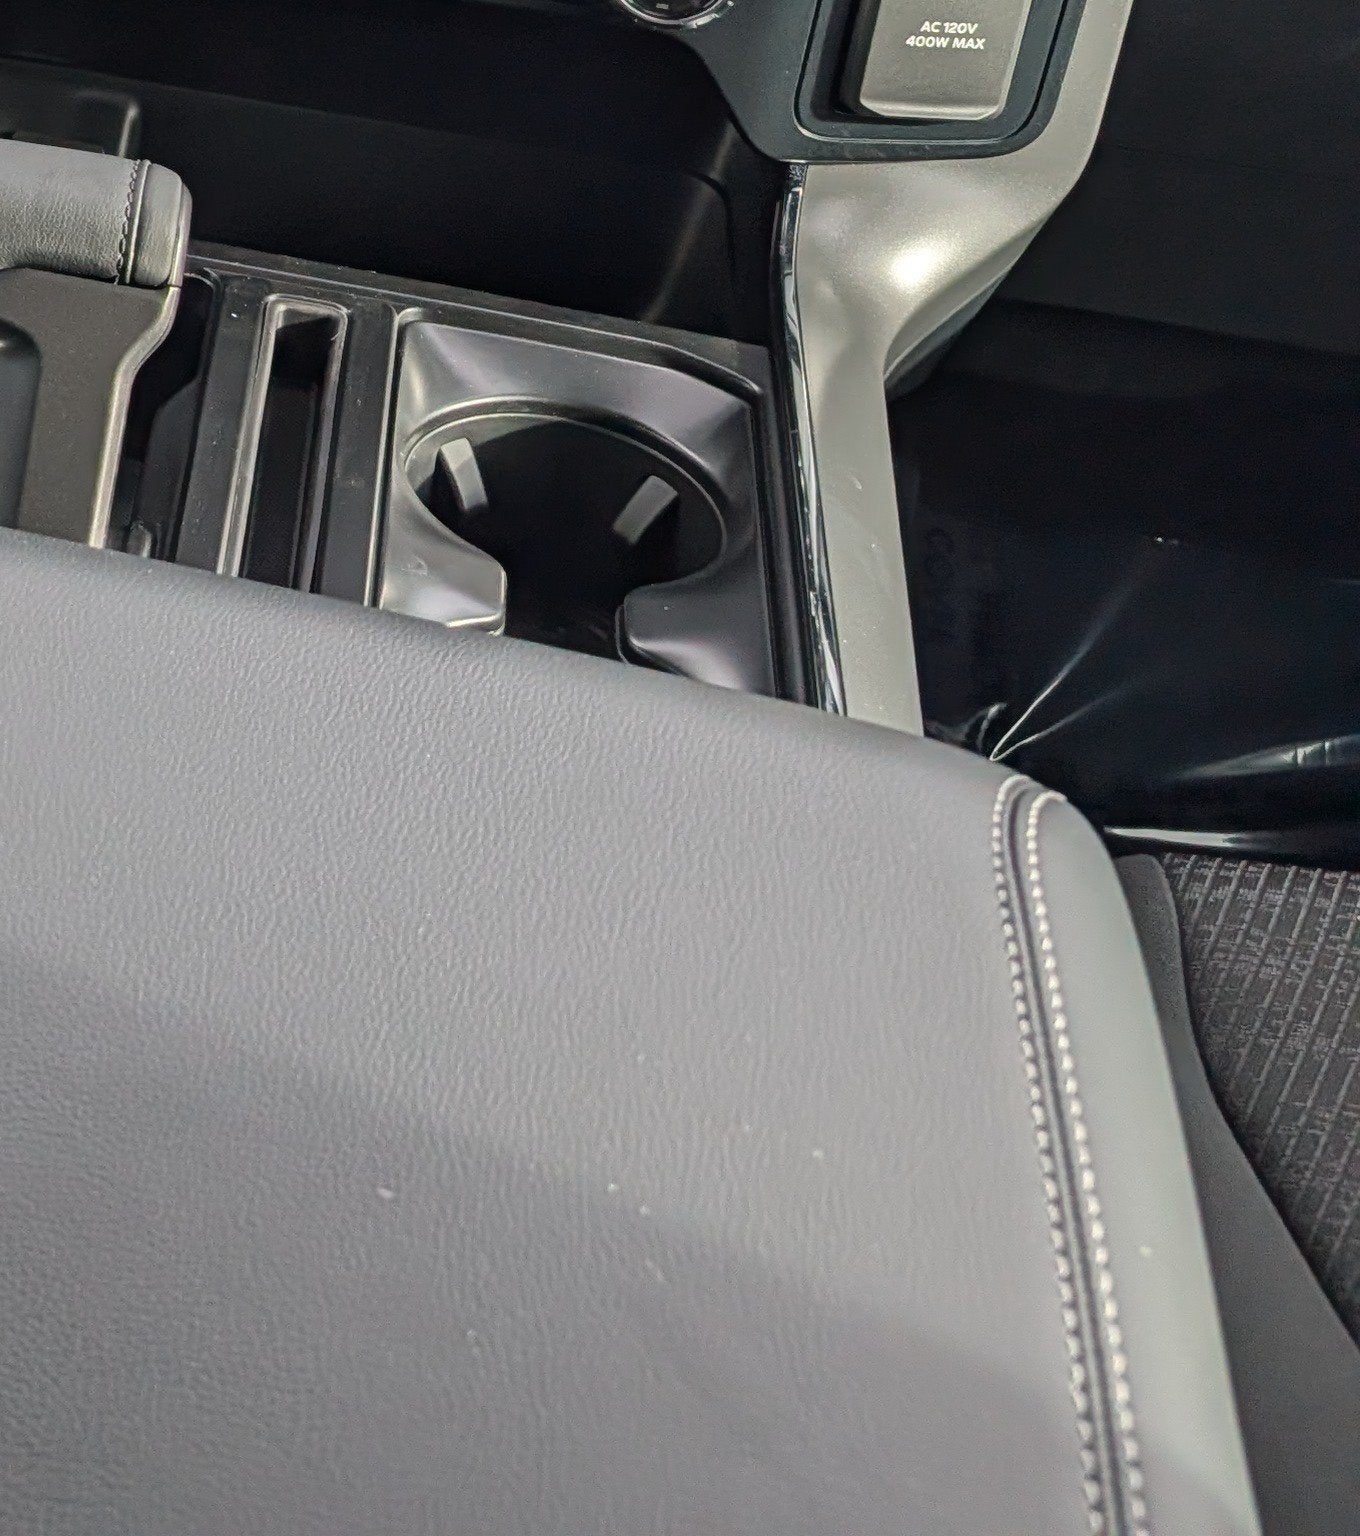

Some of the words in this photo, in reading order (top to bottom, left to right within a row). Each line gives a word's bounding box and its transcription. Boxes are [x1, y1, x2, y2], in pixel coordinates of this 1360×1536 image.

[920, 21, 941, 33] AC
[943, 22, 978, 35] 120V
[905, 35, 950, 48] 400W
[951, 37, 986, 50] MAX
